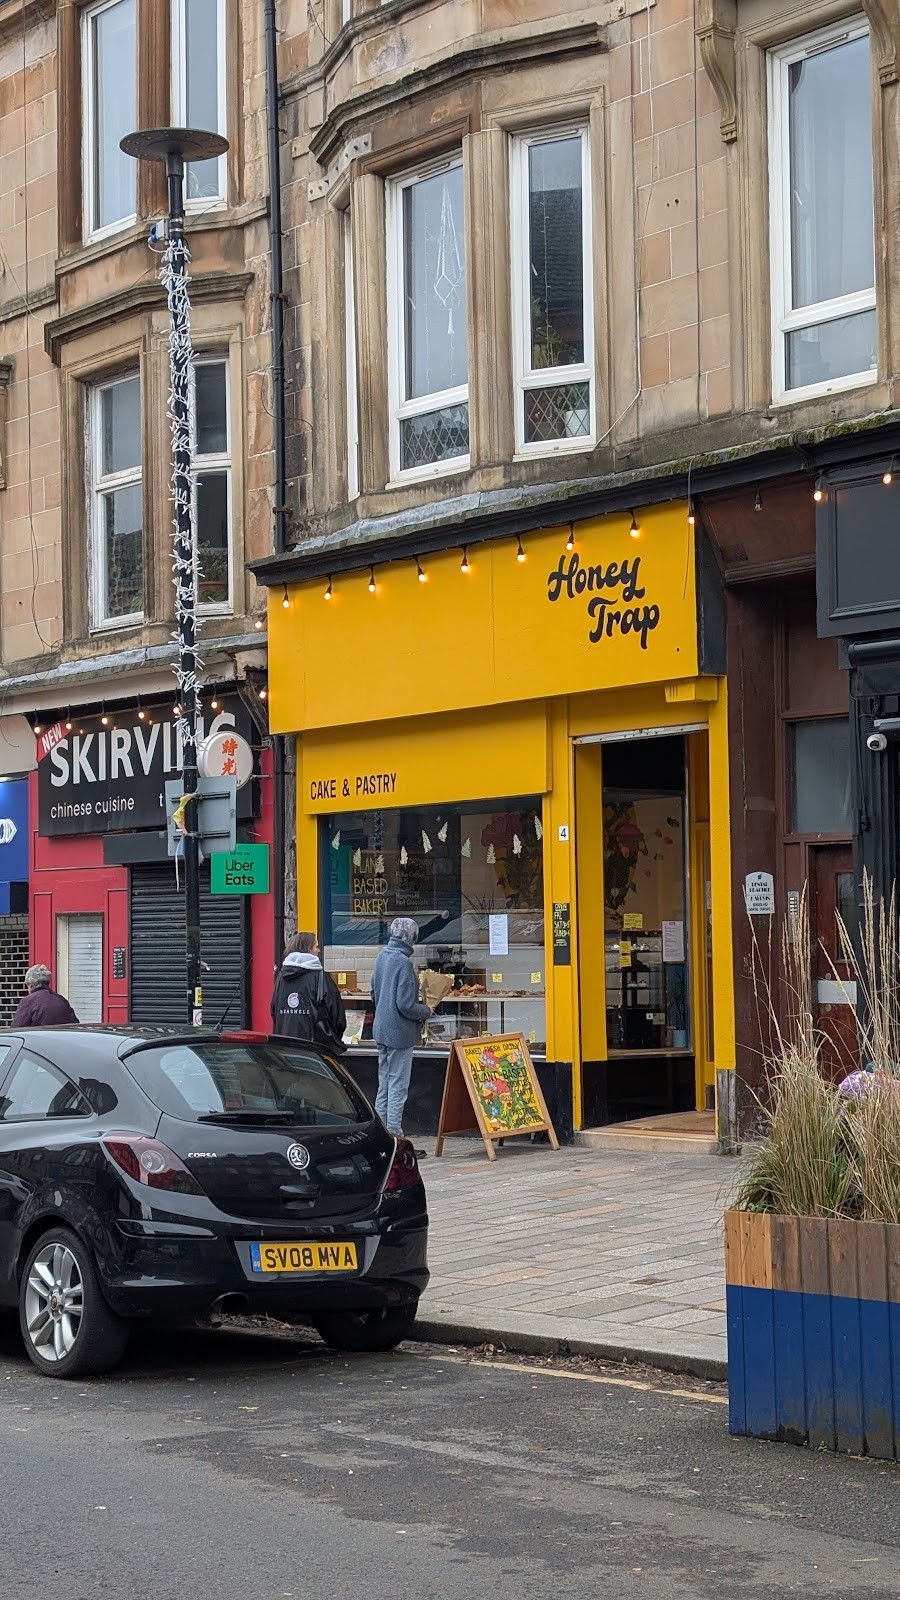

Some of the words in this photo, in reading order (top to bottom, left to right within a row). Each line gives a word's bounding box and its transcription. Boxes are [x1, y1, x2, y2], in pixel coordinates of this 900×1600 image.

[548, 552, 645, 602] Honey
[587, 597, 660, 650] Trap
[41, 722, 62, 754] NEW
[310, 779, 336, 800] CAKE
[342, 778, 350, 797] &
[356, 773, 396, 796] PASTRY
[51, 802, 92, 819] chinese
[95, 796, 135, 814] cuisine
[560, 827, 567, 839] 4
[225, 858, 255, 872] Uber
[225, 873, 255, 886] Eats
[353, 878, 389, 895] BASED
[353, 898, 389, 915] BAKERY
[265, 1247, 314, 1269] SV08
[318, 1246, 354, 1267] MVA
